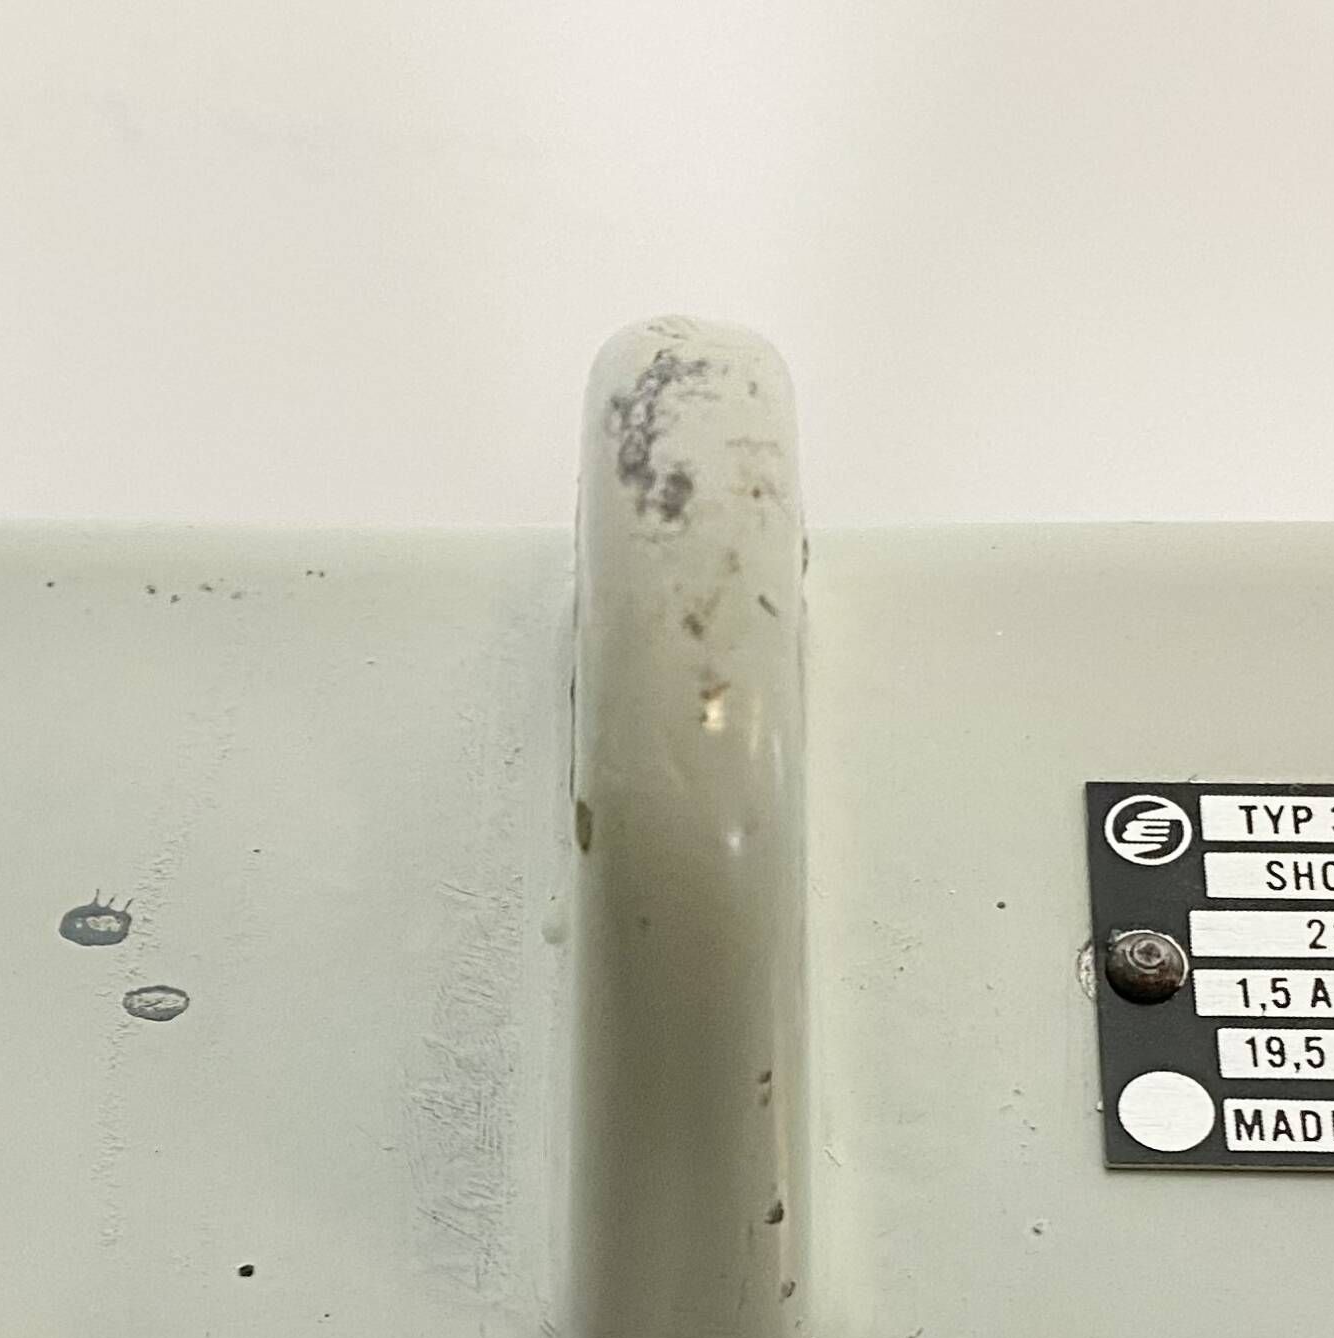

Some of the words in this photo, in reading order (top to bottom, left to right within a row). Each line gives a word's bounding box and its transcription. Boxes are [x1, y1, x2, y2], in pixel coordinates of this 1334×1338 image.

[1238, 804, 1313, 836] TYP
[1235, 976, 1292, 1012] 1,5
[1310, 976, 1333, 1010] A
[1244, 1035, 1326, 1073] 19,5
